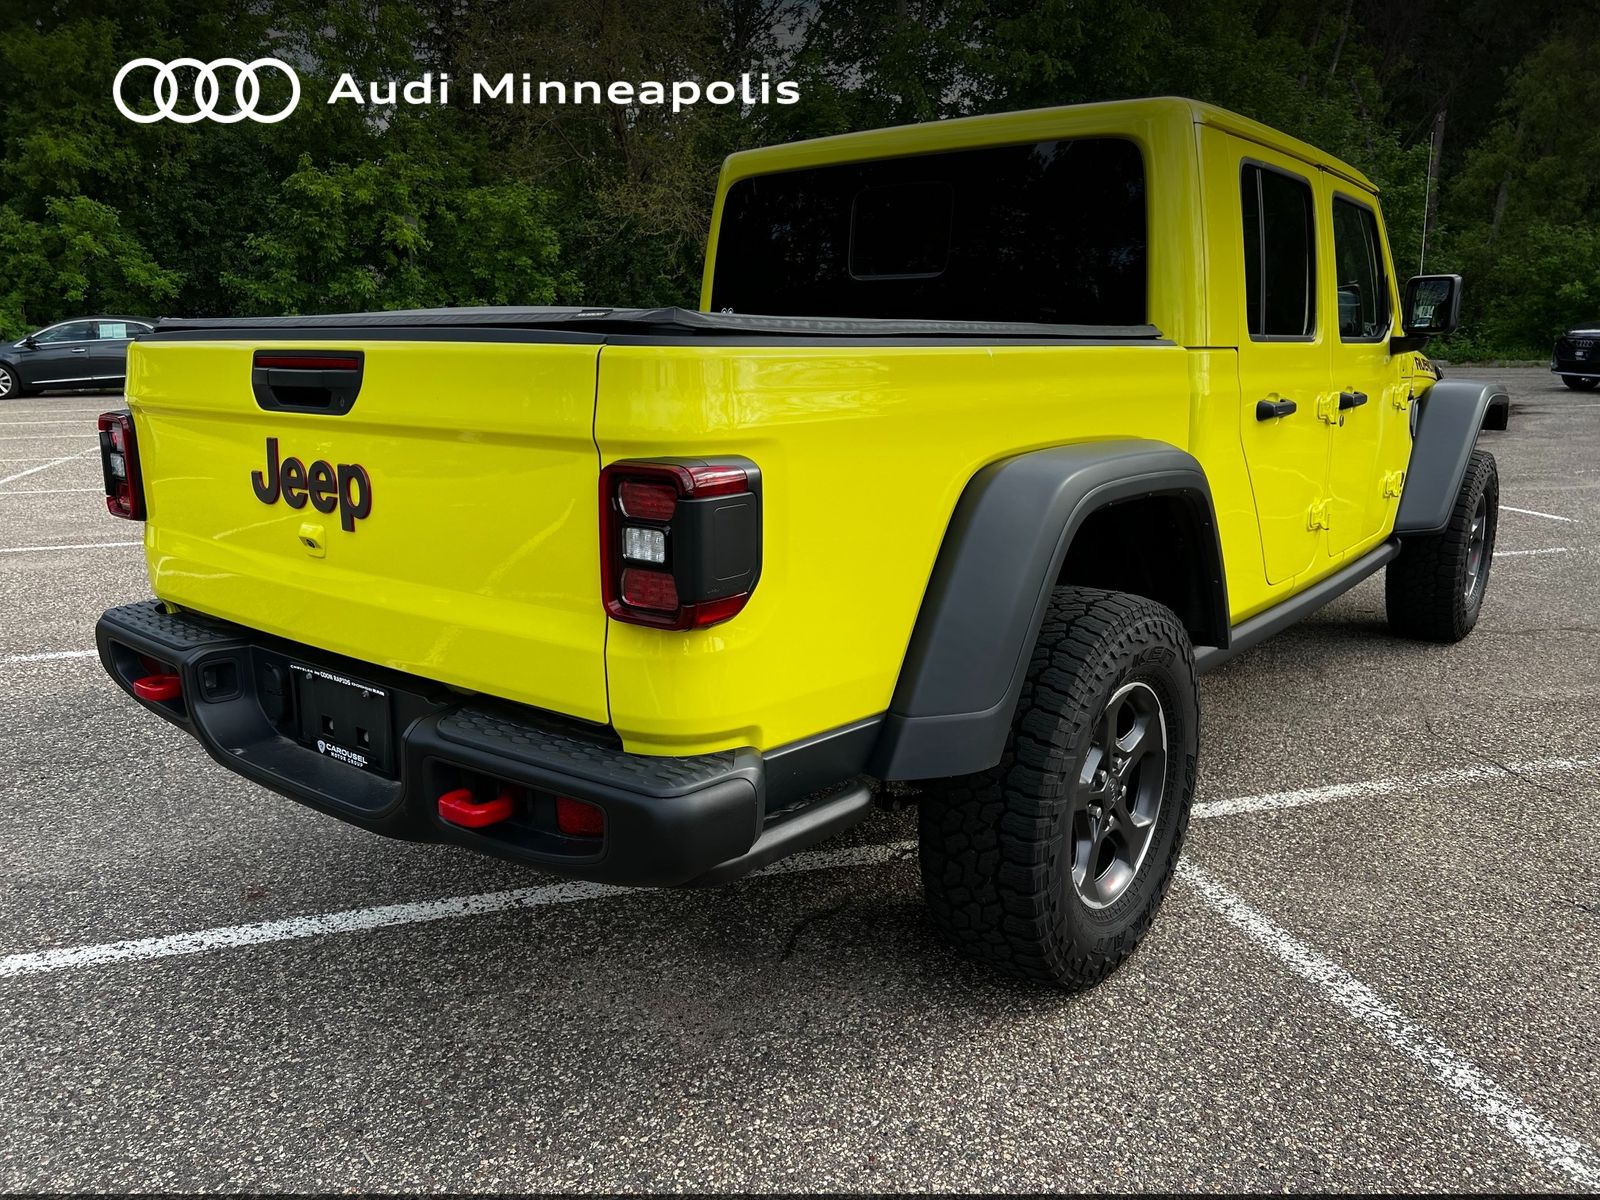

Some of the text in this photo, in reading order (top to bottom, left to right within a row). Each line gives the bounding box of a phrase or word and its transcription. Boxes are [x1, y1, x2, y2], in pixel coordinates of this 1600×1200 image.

[251, 437, 372, 532] Jeep
[325, 743, 368, 764] CAROUSEL
[330, 751, 364, 768] MOTOR GROUP
